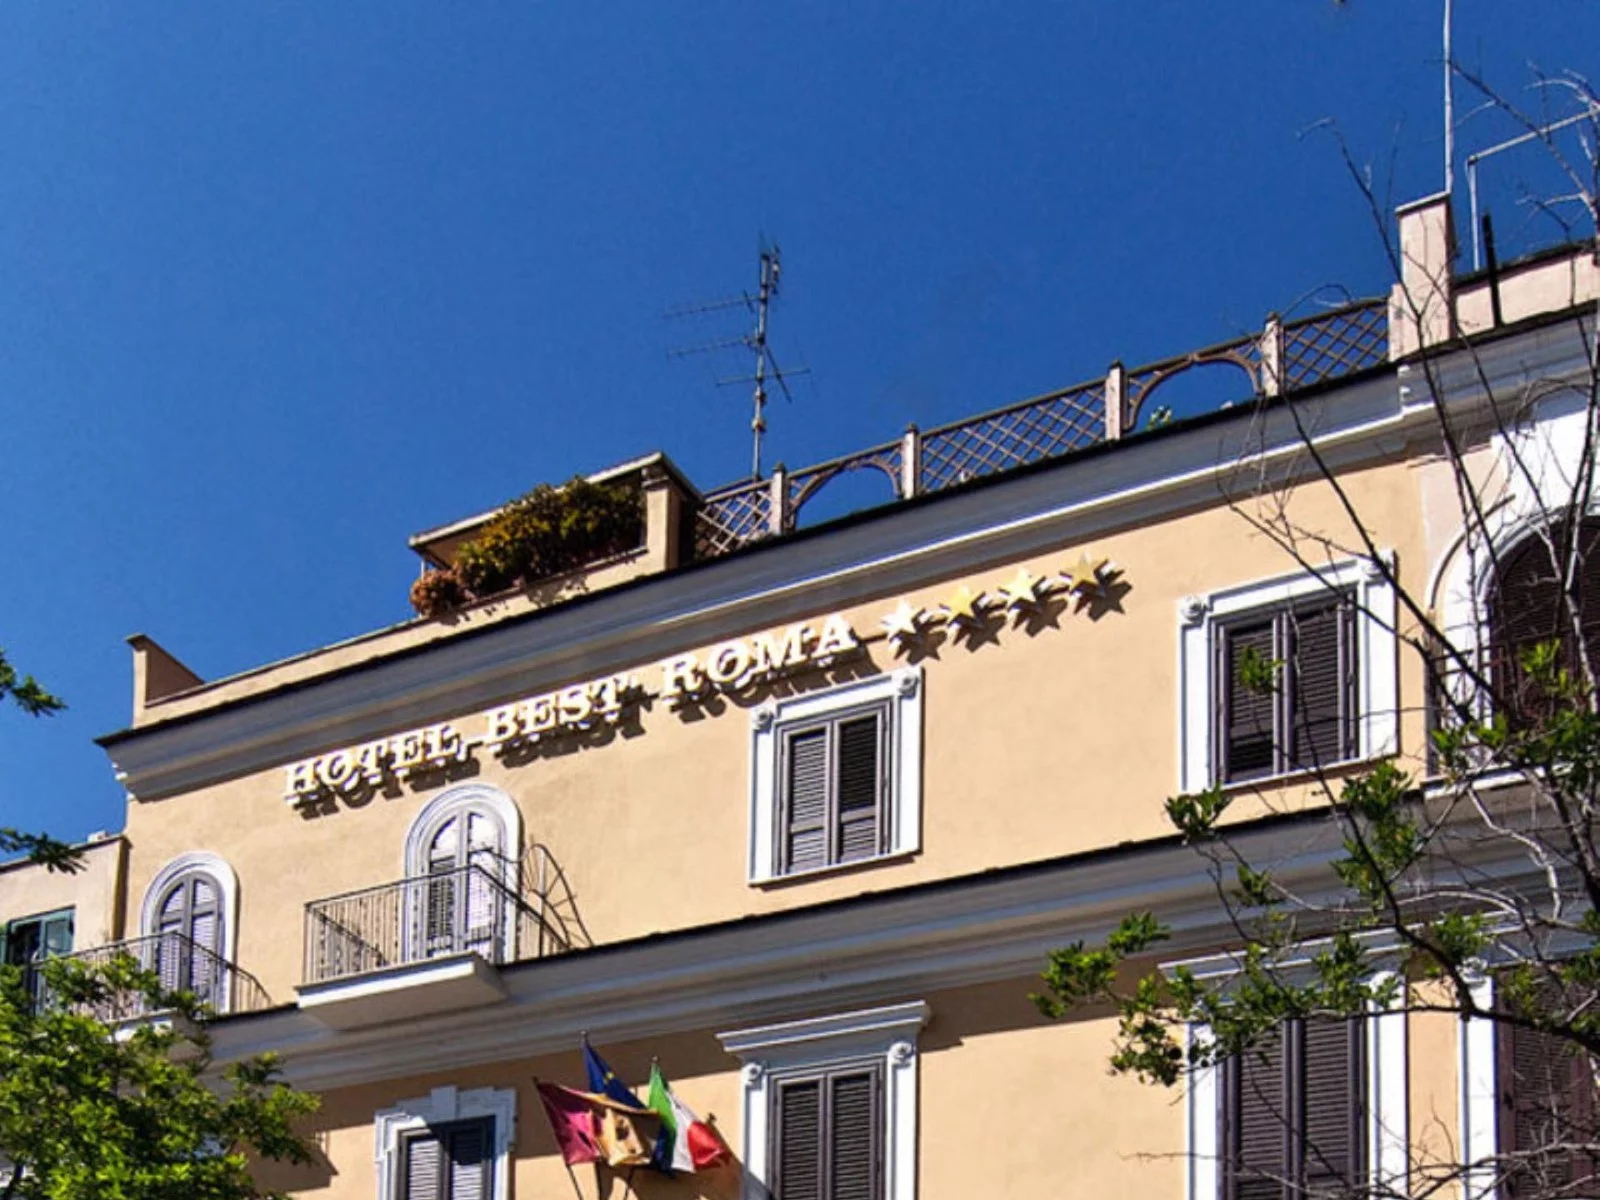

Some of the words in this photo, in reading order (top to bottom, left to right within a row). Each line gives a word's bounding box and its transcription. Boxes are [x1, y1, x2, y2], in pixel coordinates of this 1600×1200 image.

[284, 723, 462, 800] HOTEL
[484, 673, 639, 746] BEST
[660, 612, 858, 698] ROMA
